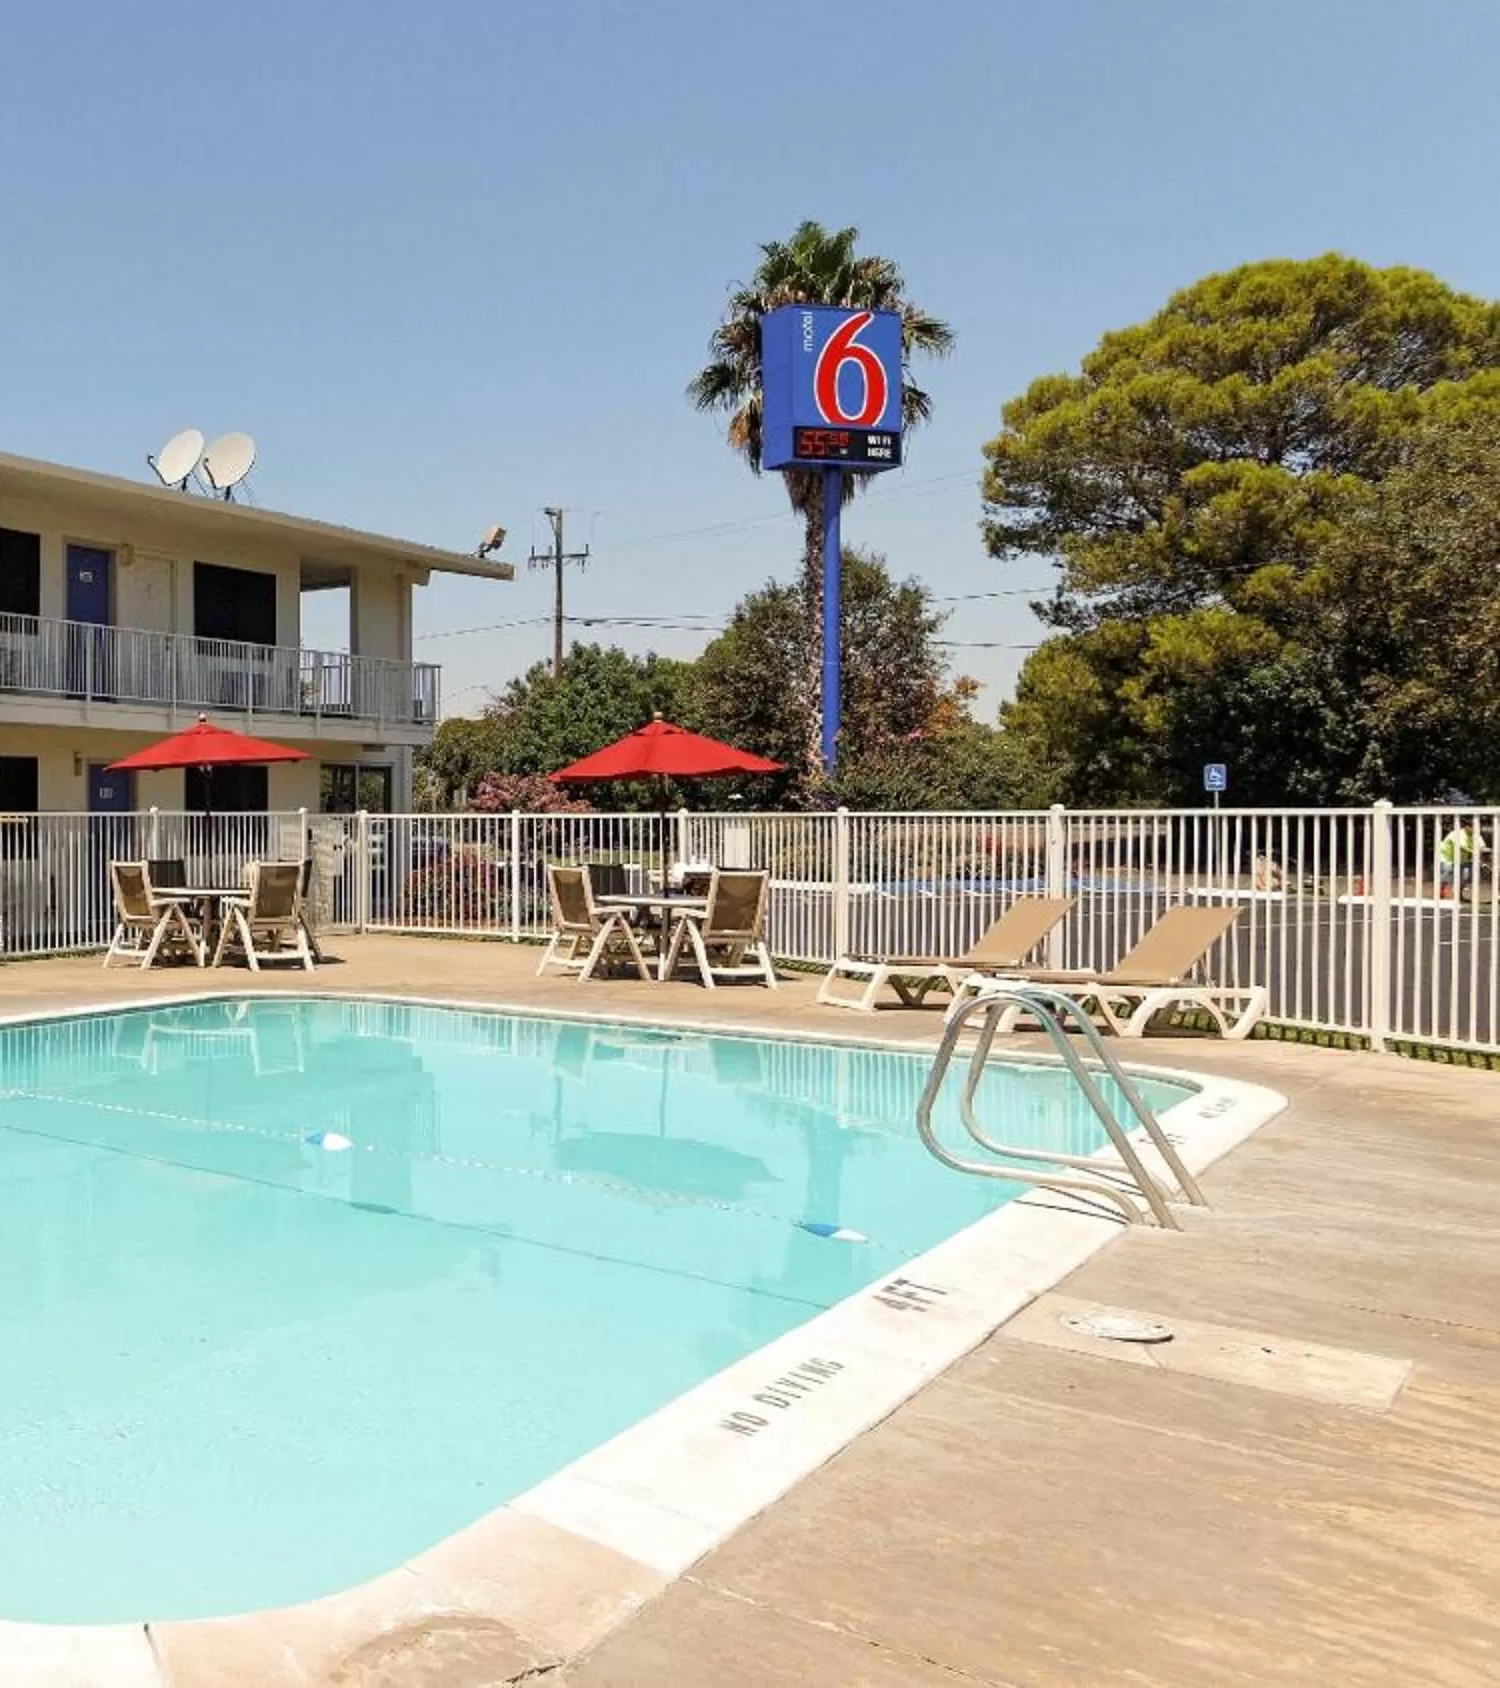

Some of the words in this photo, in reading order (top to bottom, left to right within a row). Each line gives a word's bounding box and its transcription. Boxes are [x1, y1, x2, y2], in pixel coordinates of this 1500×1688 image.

[813, 311, 889, 427] 6
[717, 1411, 770, 1438] NO
[752, 1357, 846, 1410] DIVING
